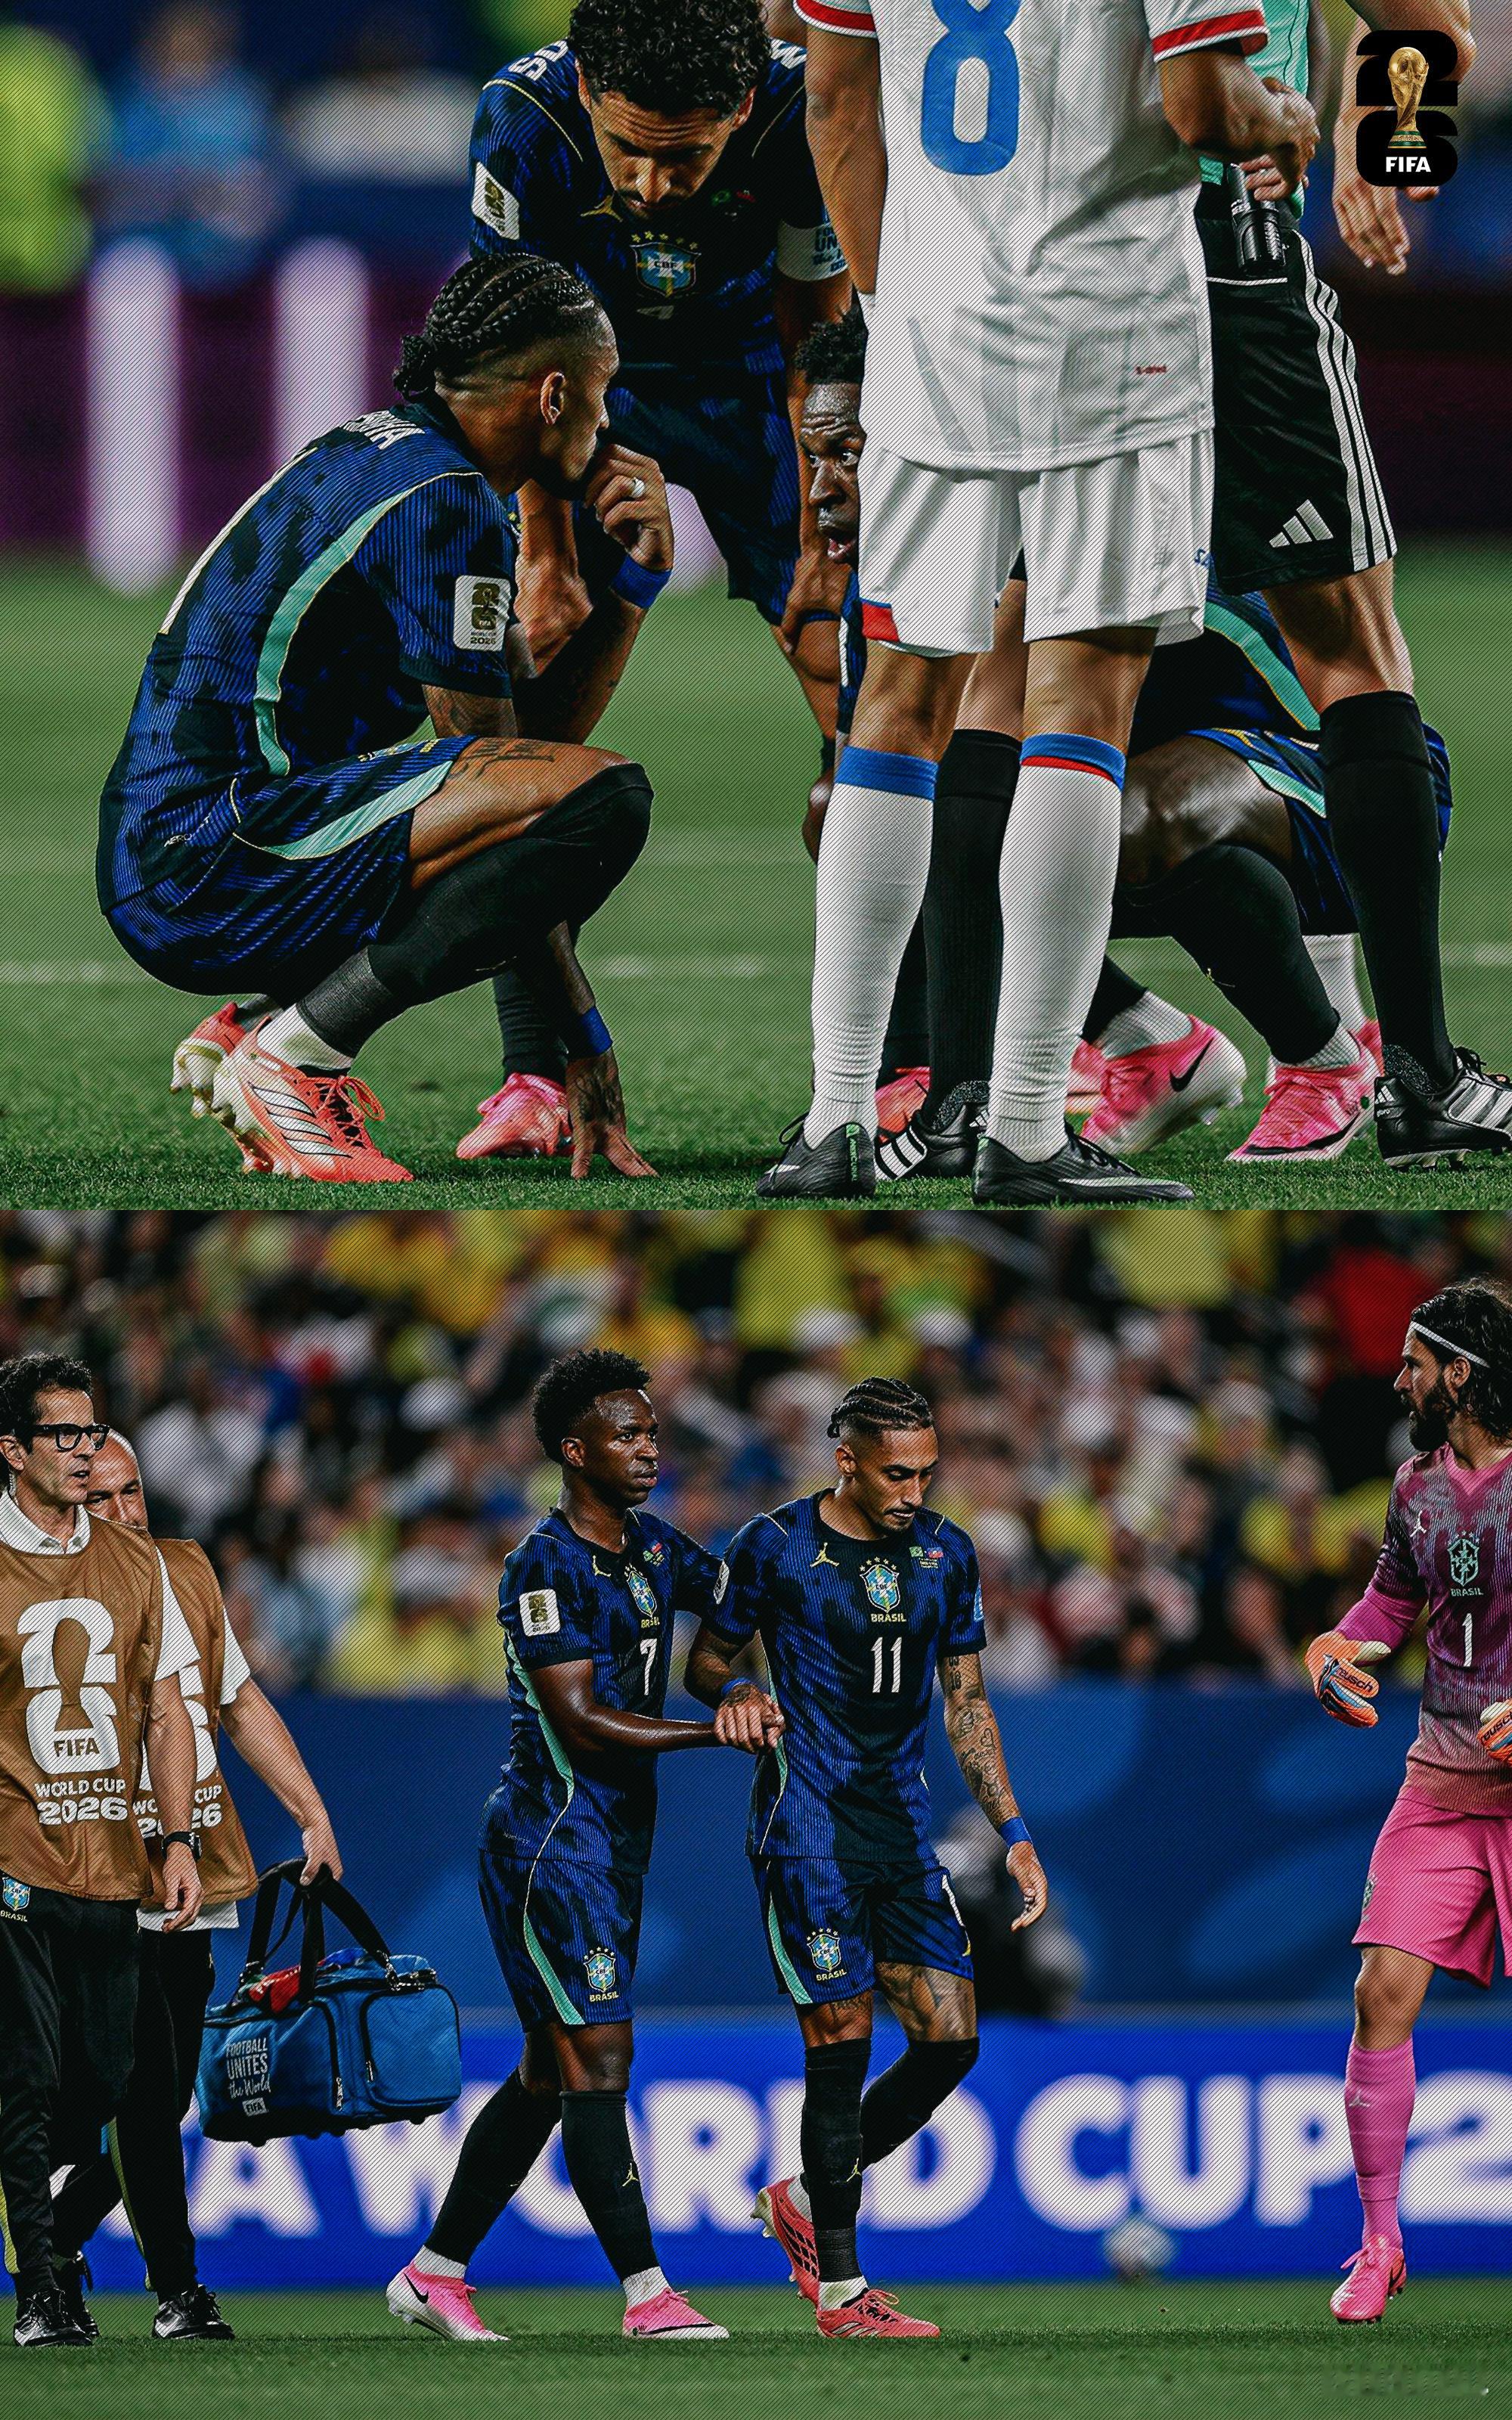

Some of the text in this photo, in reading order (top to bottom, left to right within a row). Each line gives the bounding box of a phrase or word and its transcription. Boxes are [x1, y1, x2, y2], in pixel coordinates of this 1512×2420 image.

[920, 0, 1021, 176] 8
[1451, 1588, 1483, 1596] BRASIL
[871, 1613, 906, 1623] BRASIL
[1462, 1613, 1473, 1667] 1
[640, 1639, 657, 1696] 7
[871, 1637, 902, 1693] 11
[1337, 1667, 1374, 1692] reusch
[54, 1738, 100, 1757] FIFA
[35, 1779, 126, 1798] WORLD CUP
[194, 1785, 222, 1804] CUP
[38, 1796, 128, 1826] 2026
[0, 1910, 28, 1922] BRASIL
[816, 1969, 847, 1981] BRASIL
[590, 1991, 618, 2002] BRASIL
[227, 2037, 268, 2057] FOOTBALL
[227, 2052, 268, 2080] UNITES
[228, 2073, 271, 2099] the World
[246, 2103, 264, 2113] FIFA
[1015, 2072, 1357, 2231] CUP
